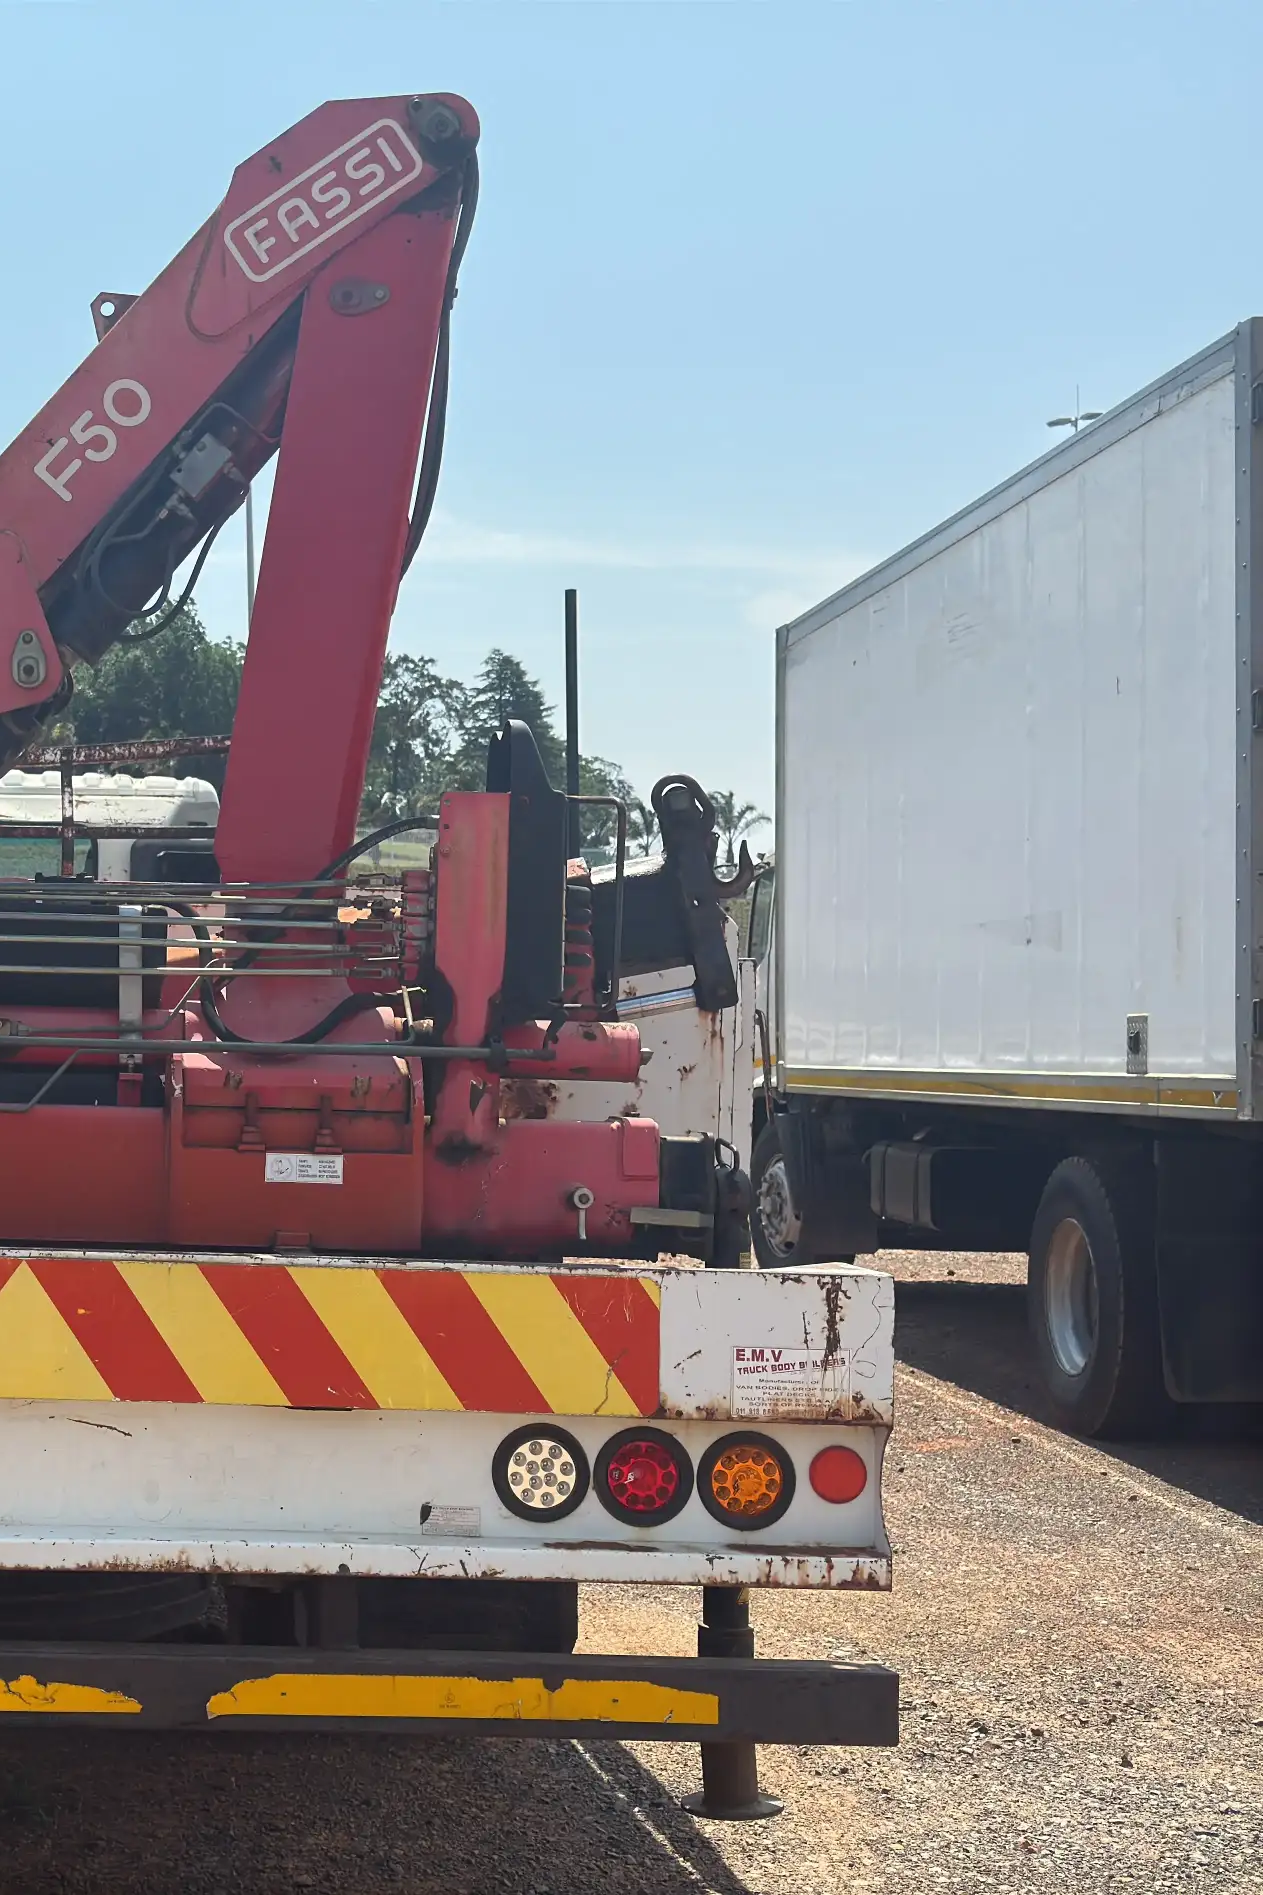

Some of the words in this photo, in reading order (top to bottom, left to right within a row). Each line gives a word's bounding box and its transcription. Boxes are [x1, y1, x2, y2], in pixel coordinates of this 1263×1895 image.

[244, 137, 402, 264] FASSI
[34, 379, 151, 502] F50
[735, 1348, 783, 1362] E.M.V
[737, 1364, 768, 1375] TRUCK
[771, 1362, 796, 1372] BODY
